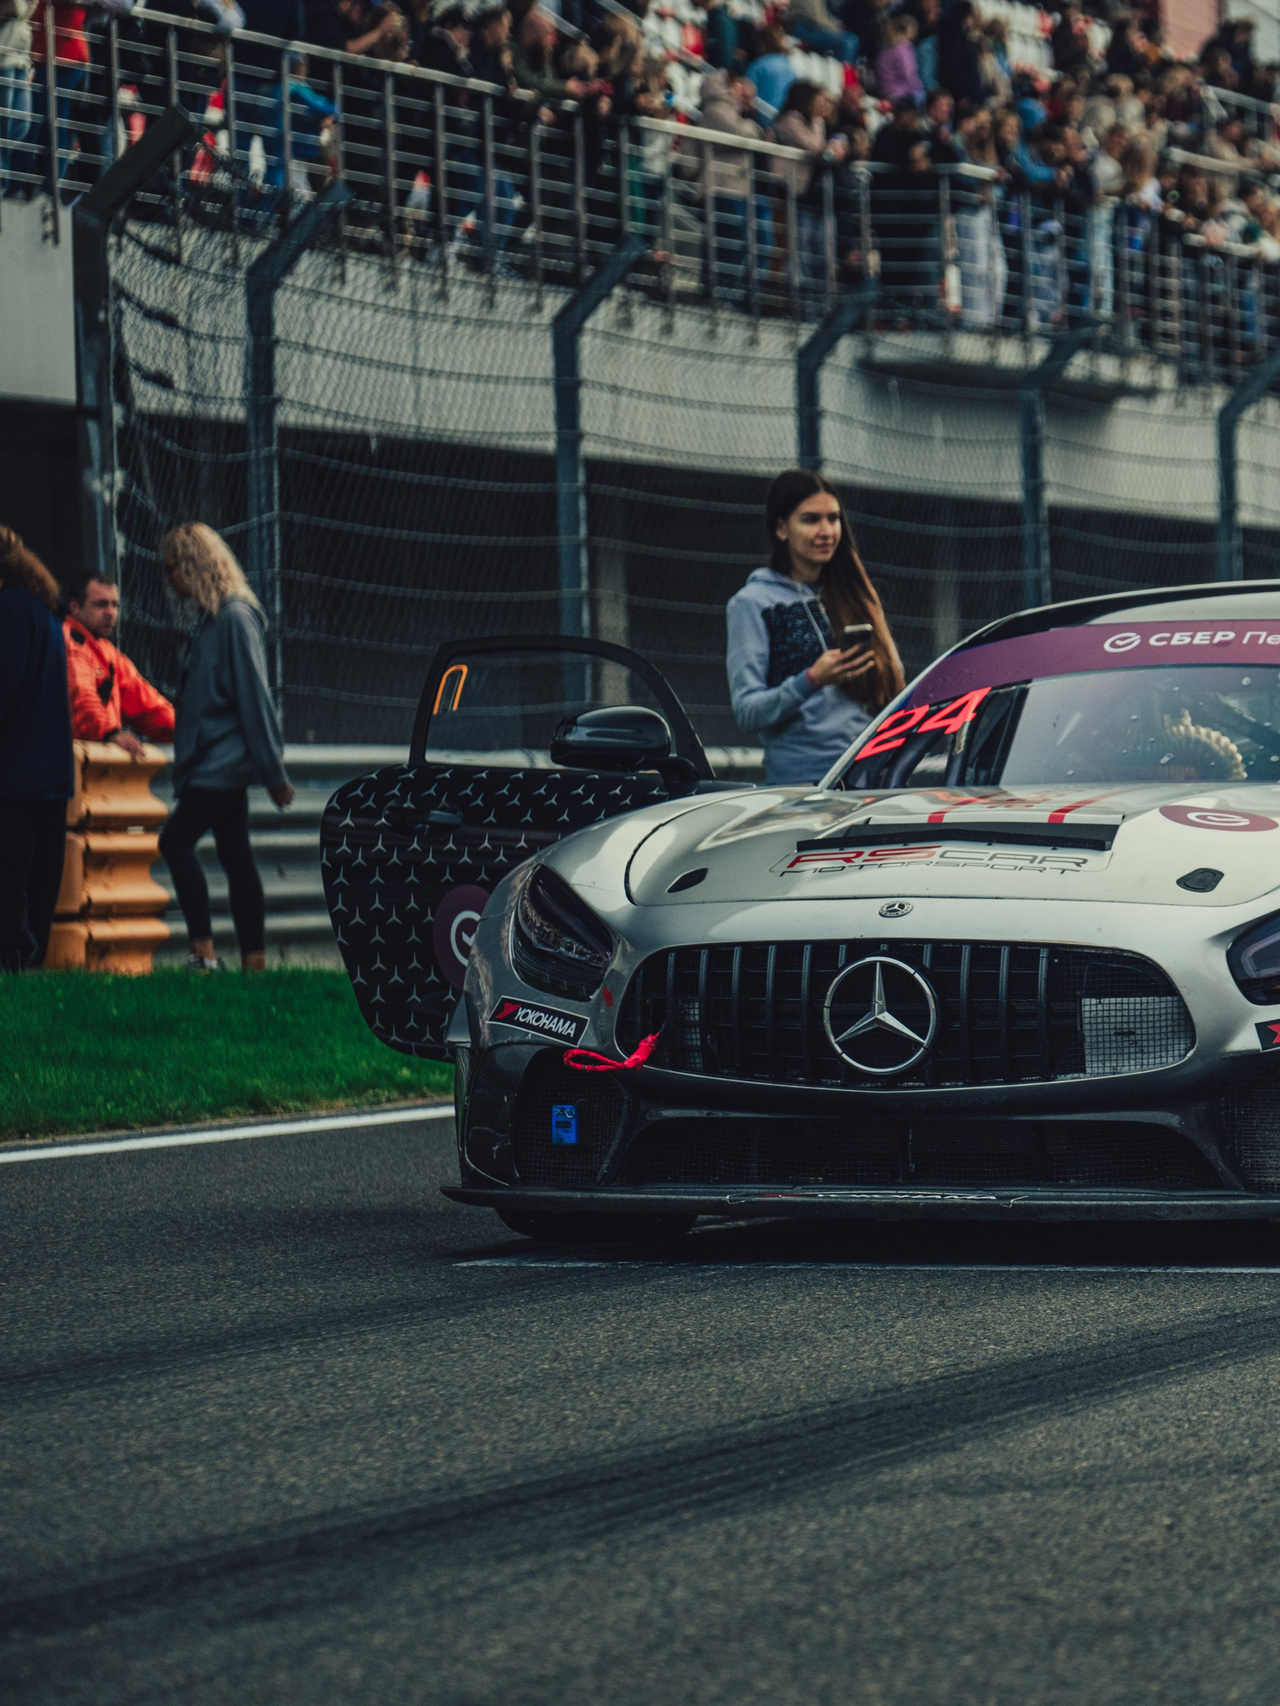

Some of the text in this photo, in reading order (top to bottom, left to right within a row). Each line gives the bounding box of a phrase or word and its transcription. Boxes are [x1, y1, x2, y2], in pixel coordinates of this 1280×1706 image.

[1149, 631, 1235, 646] СБЕР
[855, 687, 992, 761] 24
[779, 860, 1081, 878] MOTORSPORT
[514, 1007, 577, 1037] YOKOHAMA
